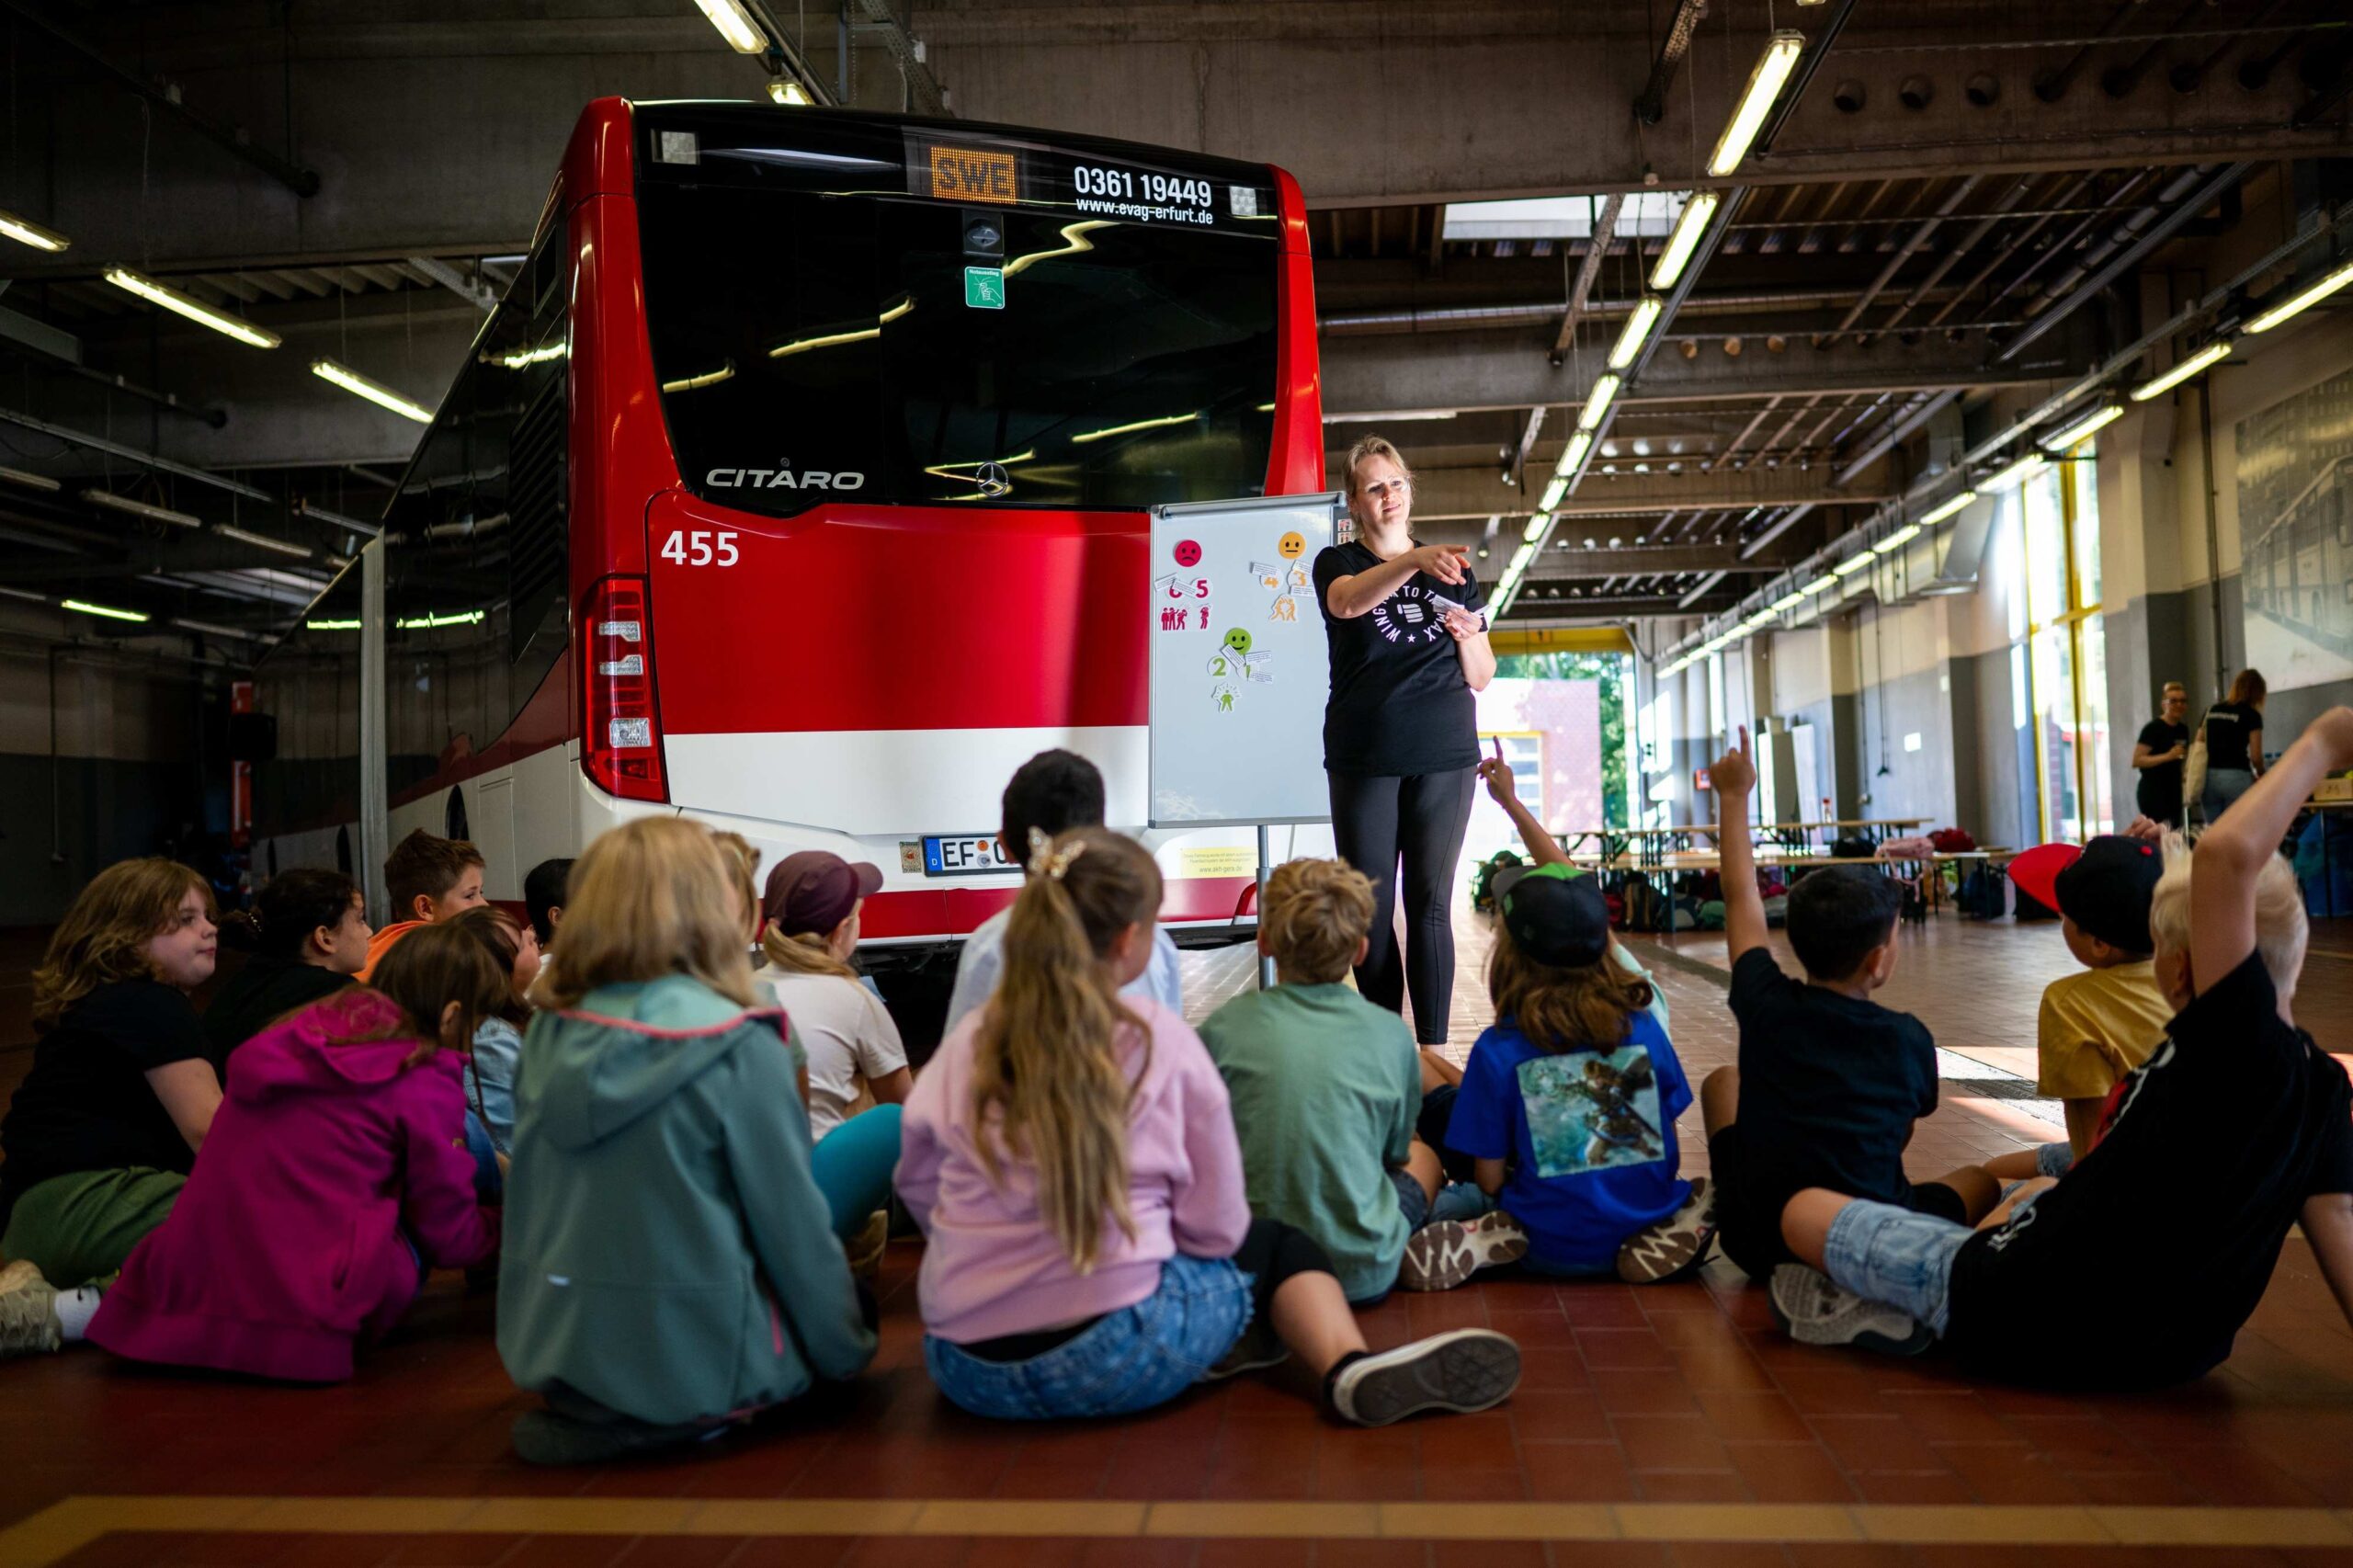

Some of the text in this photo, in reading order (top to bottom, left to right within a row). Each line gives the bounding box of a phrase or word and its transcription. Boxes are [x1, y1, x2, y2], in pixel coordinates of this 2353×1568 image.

[938, 157, 1009, 194] SWE
[1074, 166, 1212, 208] 0361 19449
[1075, 199, 1213, 225] www.evag-erfurt.de
[706, 469, 865, 490] CITARO
[661, 530, 740, 567] 455
[1196, 579, 1209, 598] 5
[1372, 608, 1402, 642] WING
[1403, 585, 1419, 597] TO
[1212, 657, 1227, 676] 2
[931, 858, 938, 866] D
[942, 841, 975, 867] EF
